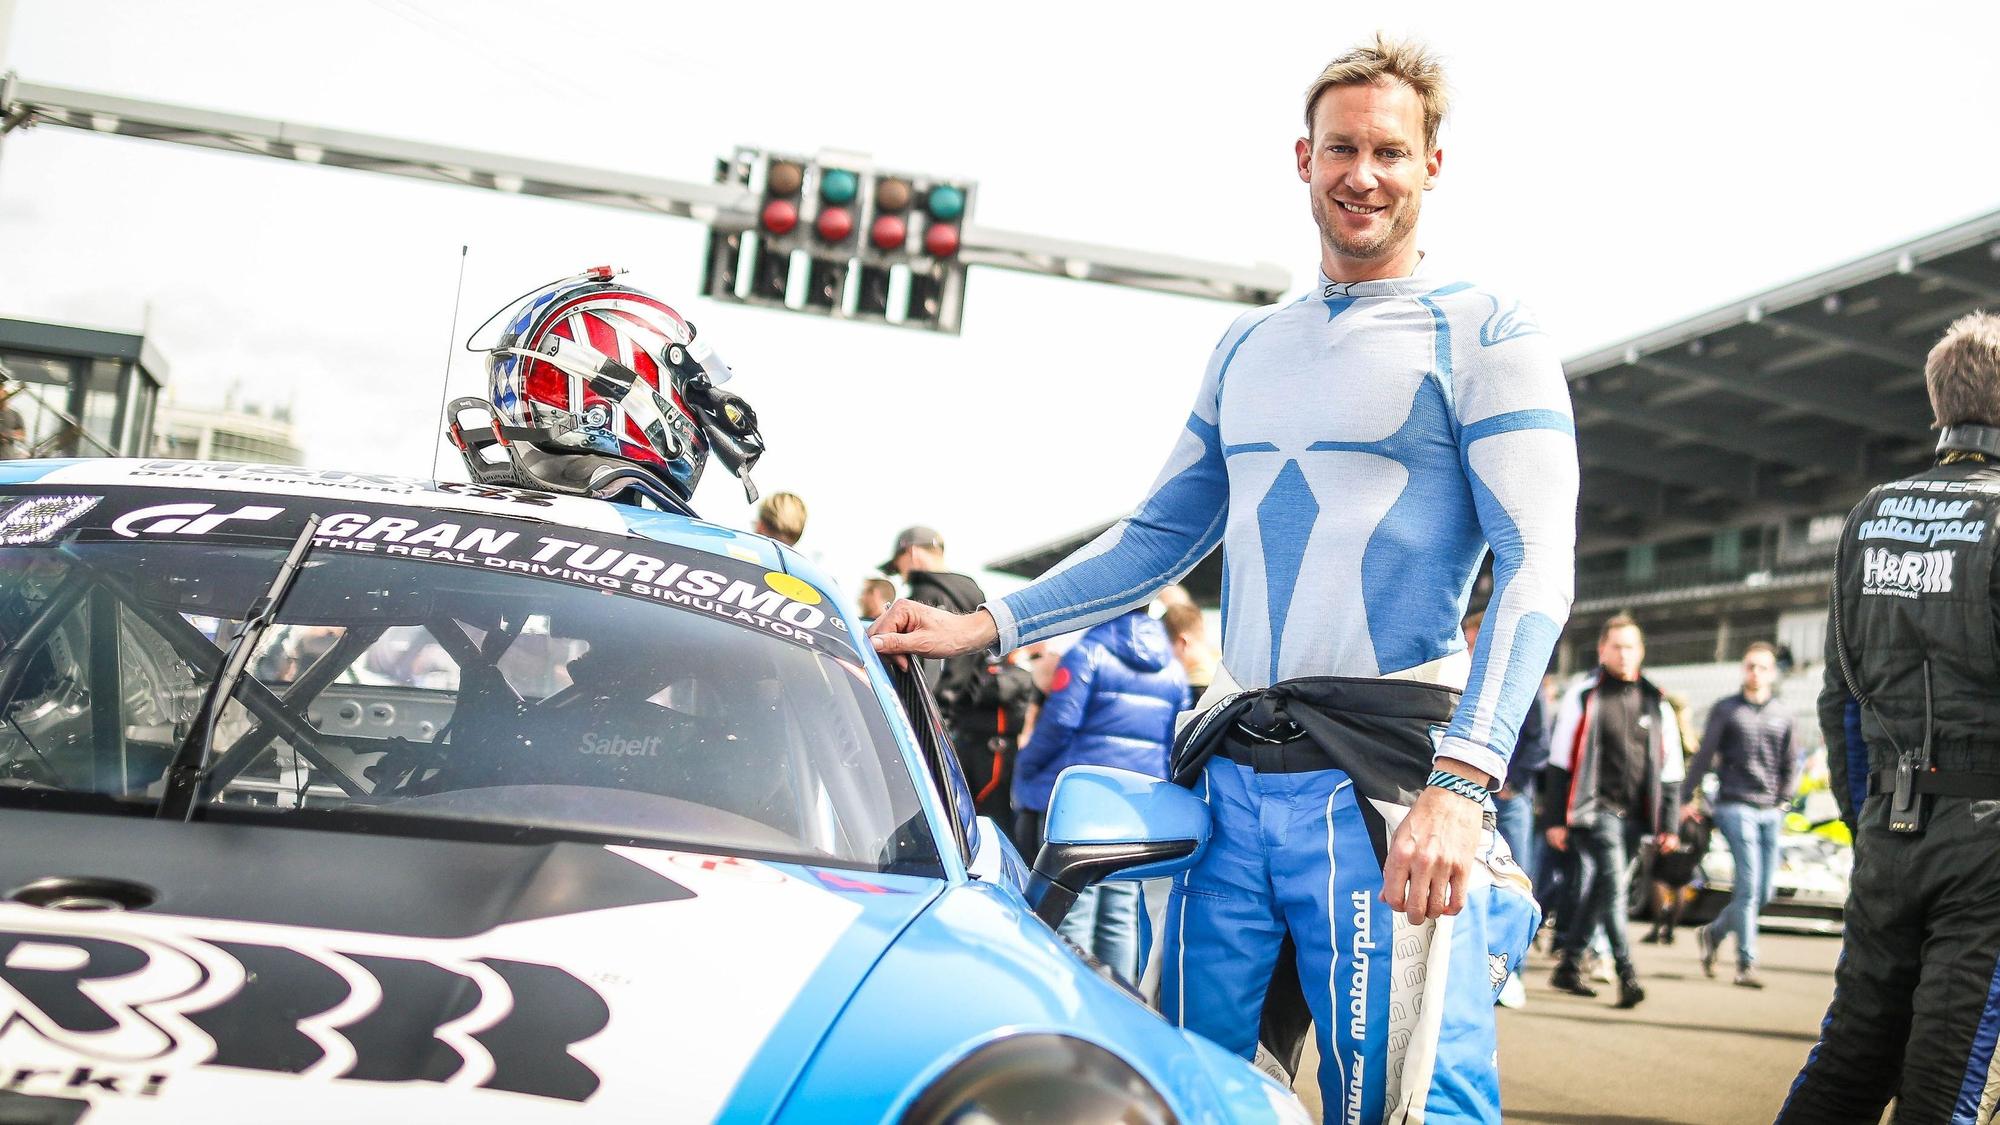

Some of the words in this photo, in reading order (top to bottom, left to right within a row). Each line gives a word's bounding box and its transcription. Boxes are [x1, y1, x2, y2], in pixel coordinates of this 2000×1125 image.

[312, 537, 377, 552] THE
[386, 544, 475, 564] REAL
[484, 556, 621, 589] DRIVING
[630, 583, 816, 645] SIMULATOR
[315, 512, 520, 555] GRAN
[531, 536, 826, 629] TURISMO
[1863, 547, 1924, 592] H&R
[578, 732, 662, 757] Sabelt
[1350, 890, 1376, 1041] motorsport
